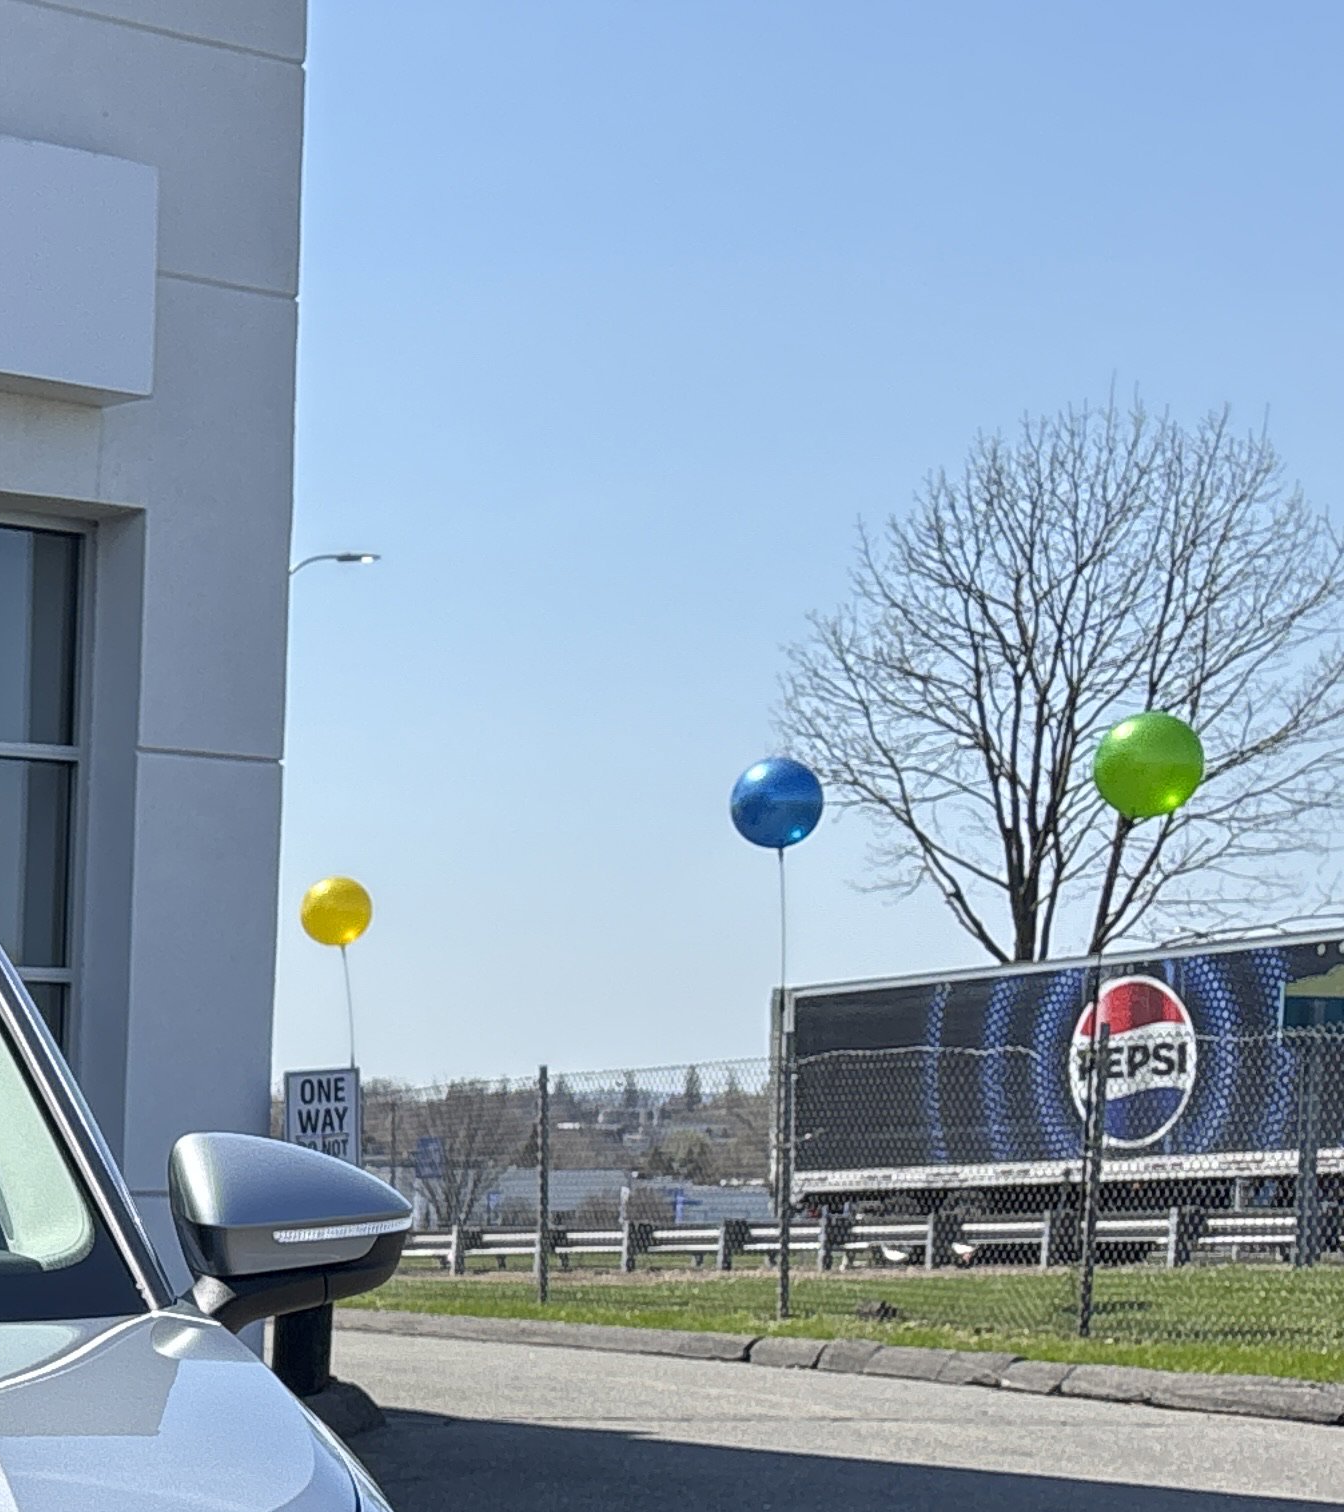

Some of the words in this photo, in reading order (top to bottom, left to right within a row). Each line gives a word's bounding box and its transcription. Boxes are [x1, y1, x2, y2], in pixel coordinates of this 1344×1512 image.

[1077, 1041, 1188, 1081] PEPSI
[300, 1076, 346, 1105] ONE
[297, 1106, 348, 1134] WAY
[322, 1139, 348, 1156] NOT
